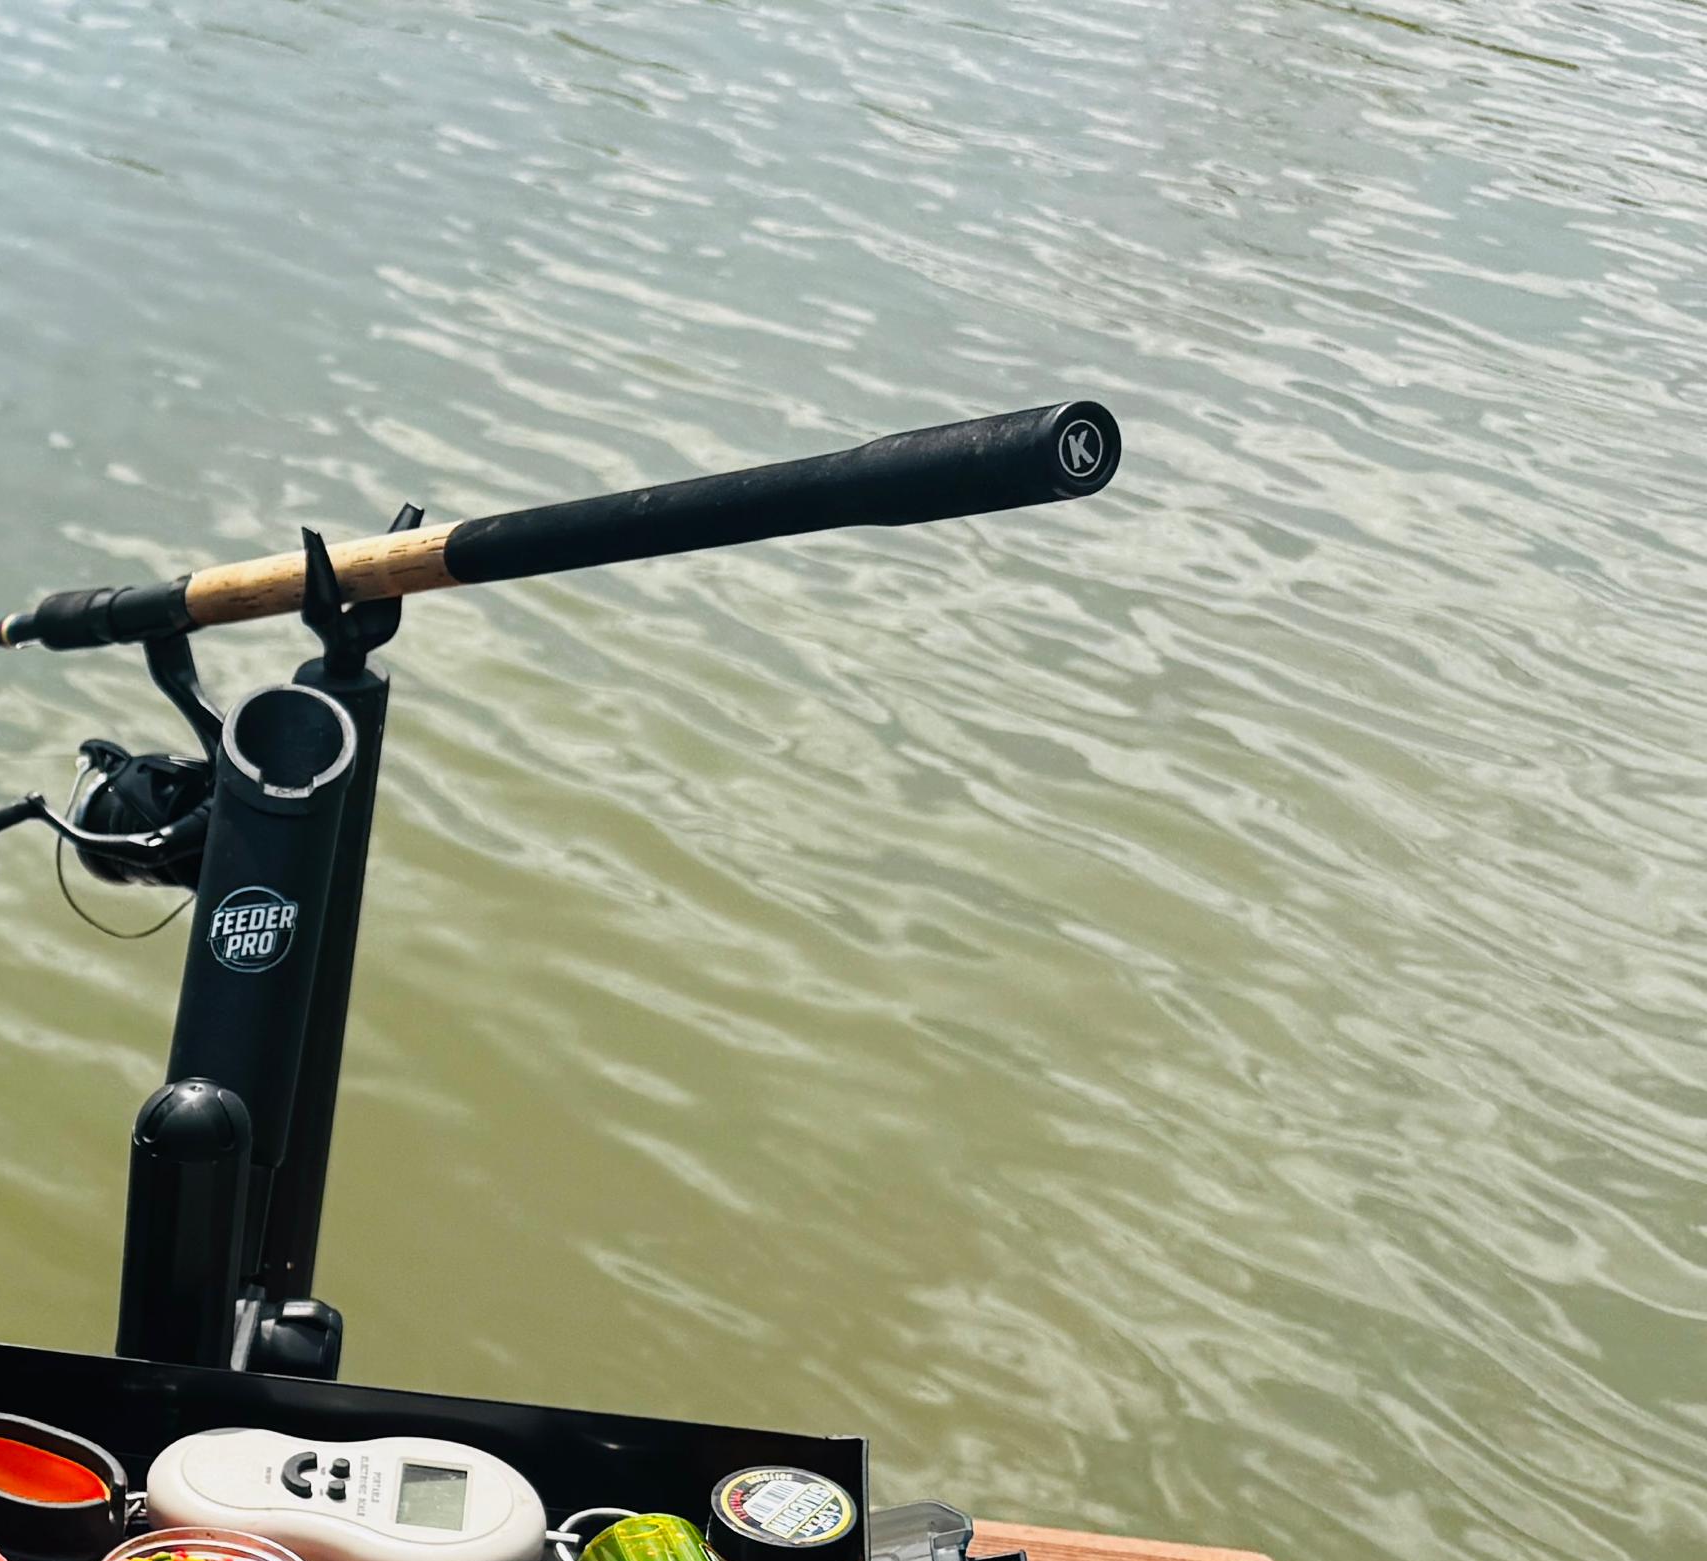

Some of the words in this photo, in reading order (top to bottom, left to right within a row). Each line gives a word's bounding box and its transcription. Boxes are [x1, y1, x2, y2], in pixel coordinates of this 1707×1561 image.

[1068, 429, 1095, 470] K
[210, 904, 296, 938] FEEDER
[225, 930, 275, 959] PRO
